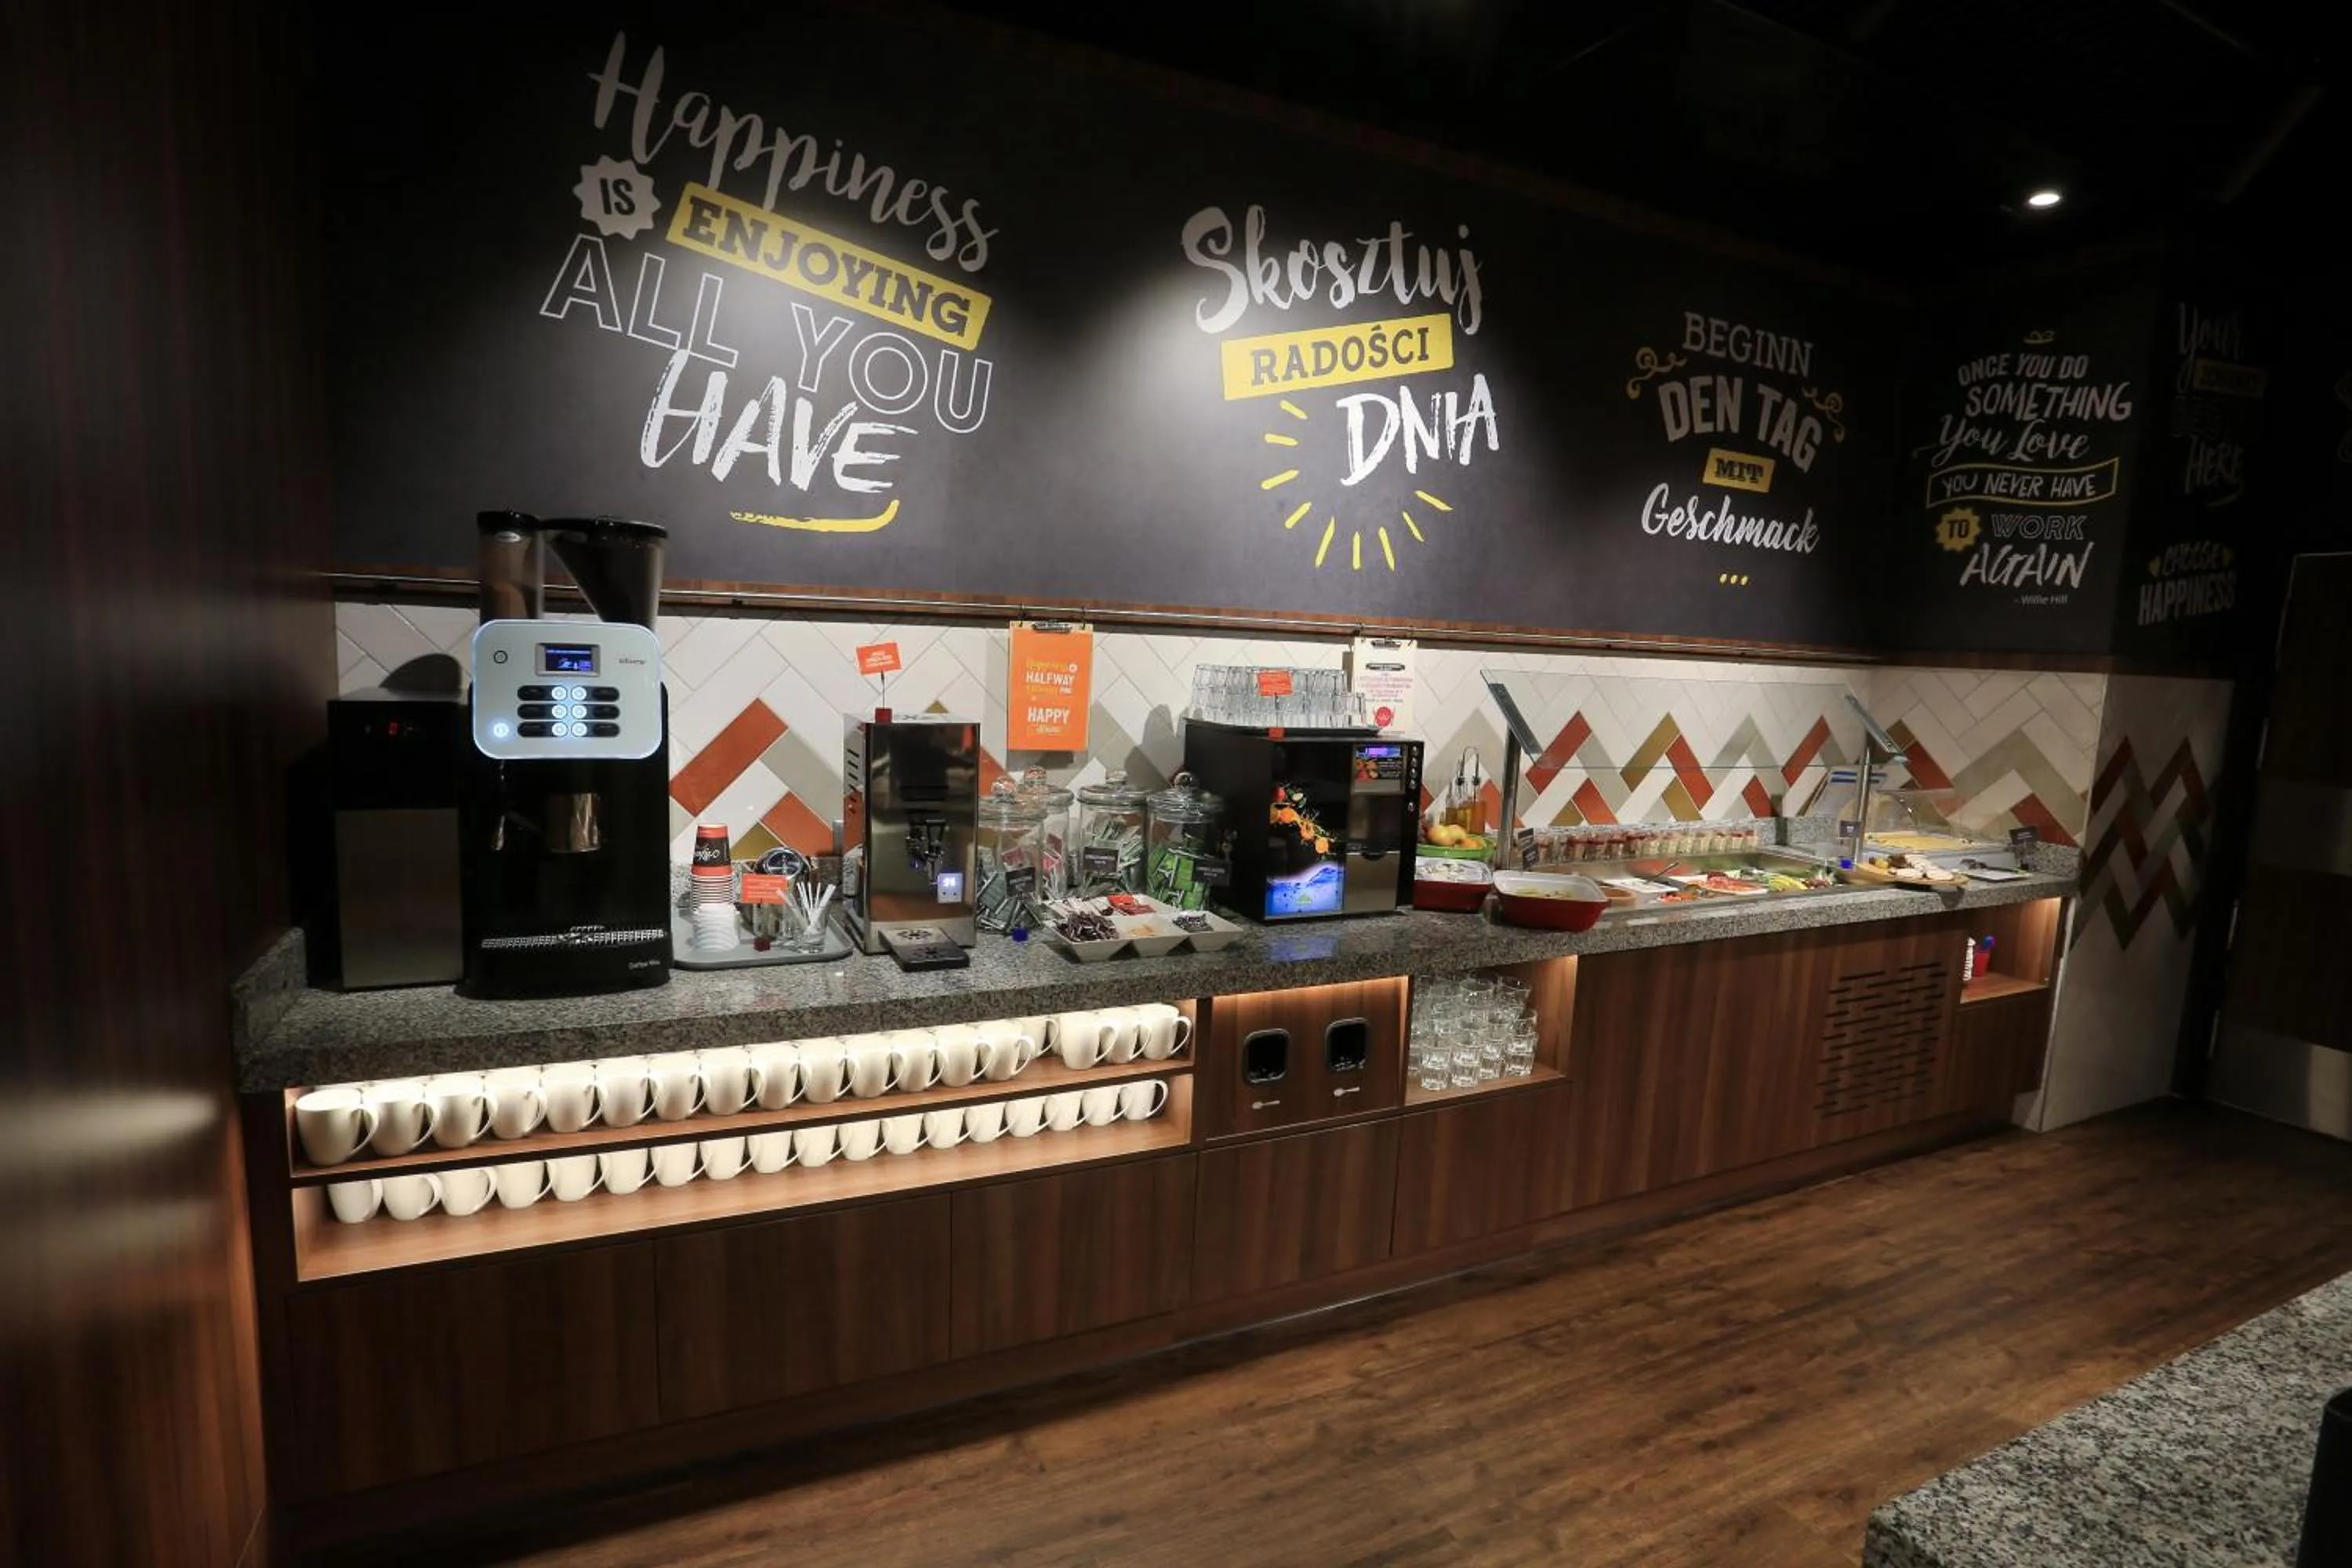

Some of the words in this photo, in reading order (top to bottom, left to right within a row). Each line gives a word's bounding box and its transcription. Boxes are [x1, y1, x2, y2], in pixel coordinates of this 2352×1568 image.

[588, 30, 999, 271] Happiness
[599, 177, 636, 216] IS
[681, 194, 972, 339] ENJOYING
[1181, 204, 1483, 336] Skosztuj
[539, 234, 739, 369] ALL
[790, 301, 993, 434] YOU
[1250, 325, 1430, 387] RADOŚCI
[1682, 311, 1814, 377] BEGINN
[1957, 352, 2011, 387] ONCE
[2015, 352, 2056, 379] YOU
[2058, 354, 2089, 380] DO
[641, 348, 918, 493] HAVE
[1657, 375, 1743, 443] DEN
[1756, 383, 1823, 474] TAG
[1965, 380, 2133, 422] SOMETHING
[1335, 373, 1500, 486] DNIA
[1913, 413, 2009, 468] You
[2006, 417, 2091, 463] Love
[1714, 457, 1764, 484] MIT
[1940, 473, 1978, 499] YOU
[1983, 472, 2045, 499] NEVER
[2049, 474, 2097, 499] HAVE
[1641, 481, 1820, 554] Geschmack
[1946, 519, 1970, 540] TO
[1990, 513, 2089, 541] WORK
[1959, 540, 2096, 590] AGAIN
[2137, 570, 2238, 626] HAPPINESS
[1025, 670, 1075, 687] HALFWAY
[1027, 706, 1070, 725] HAPPY
